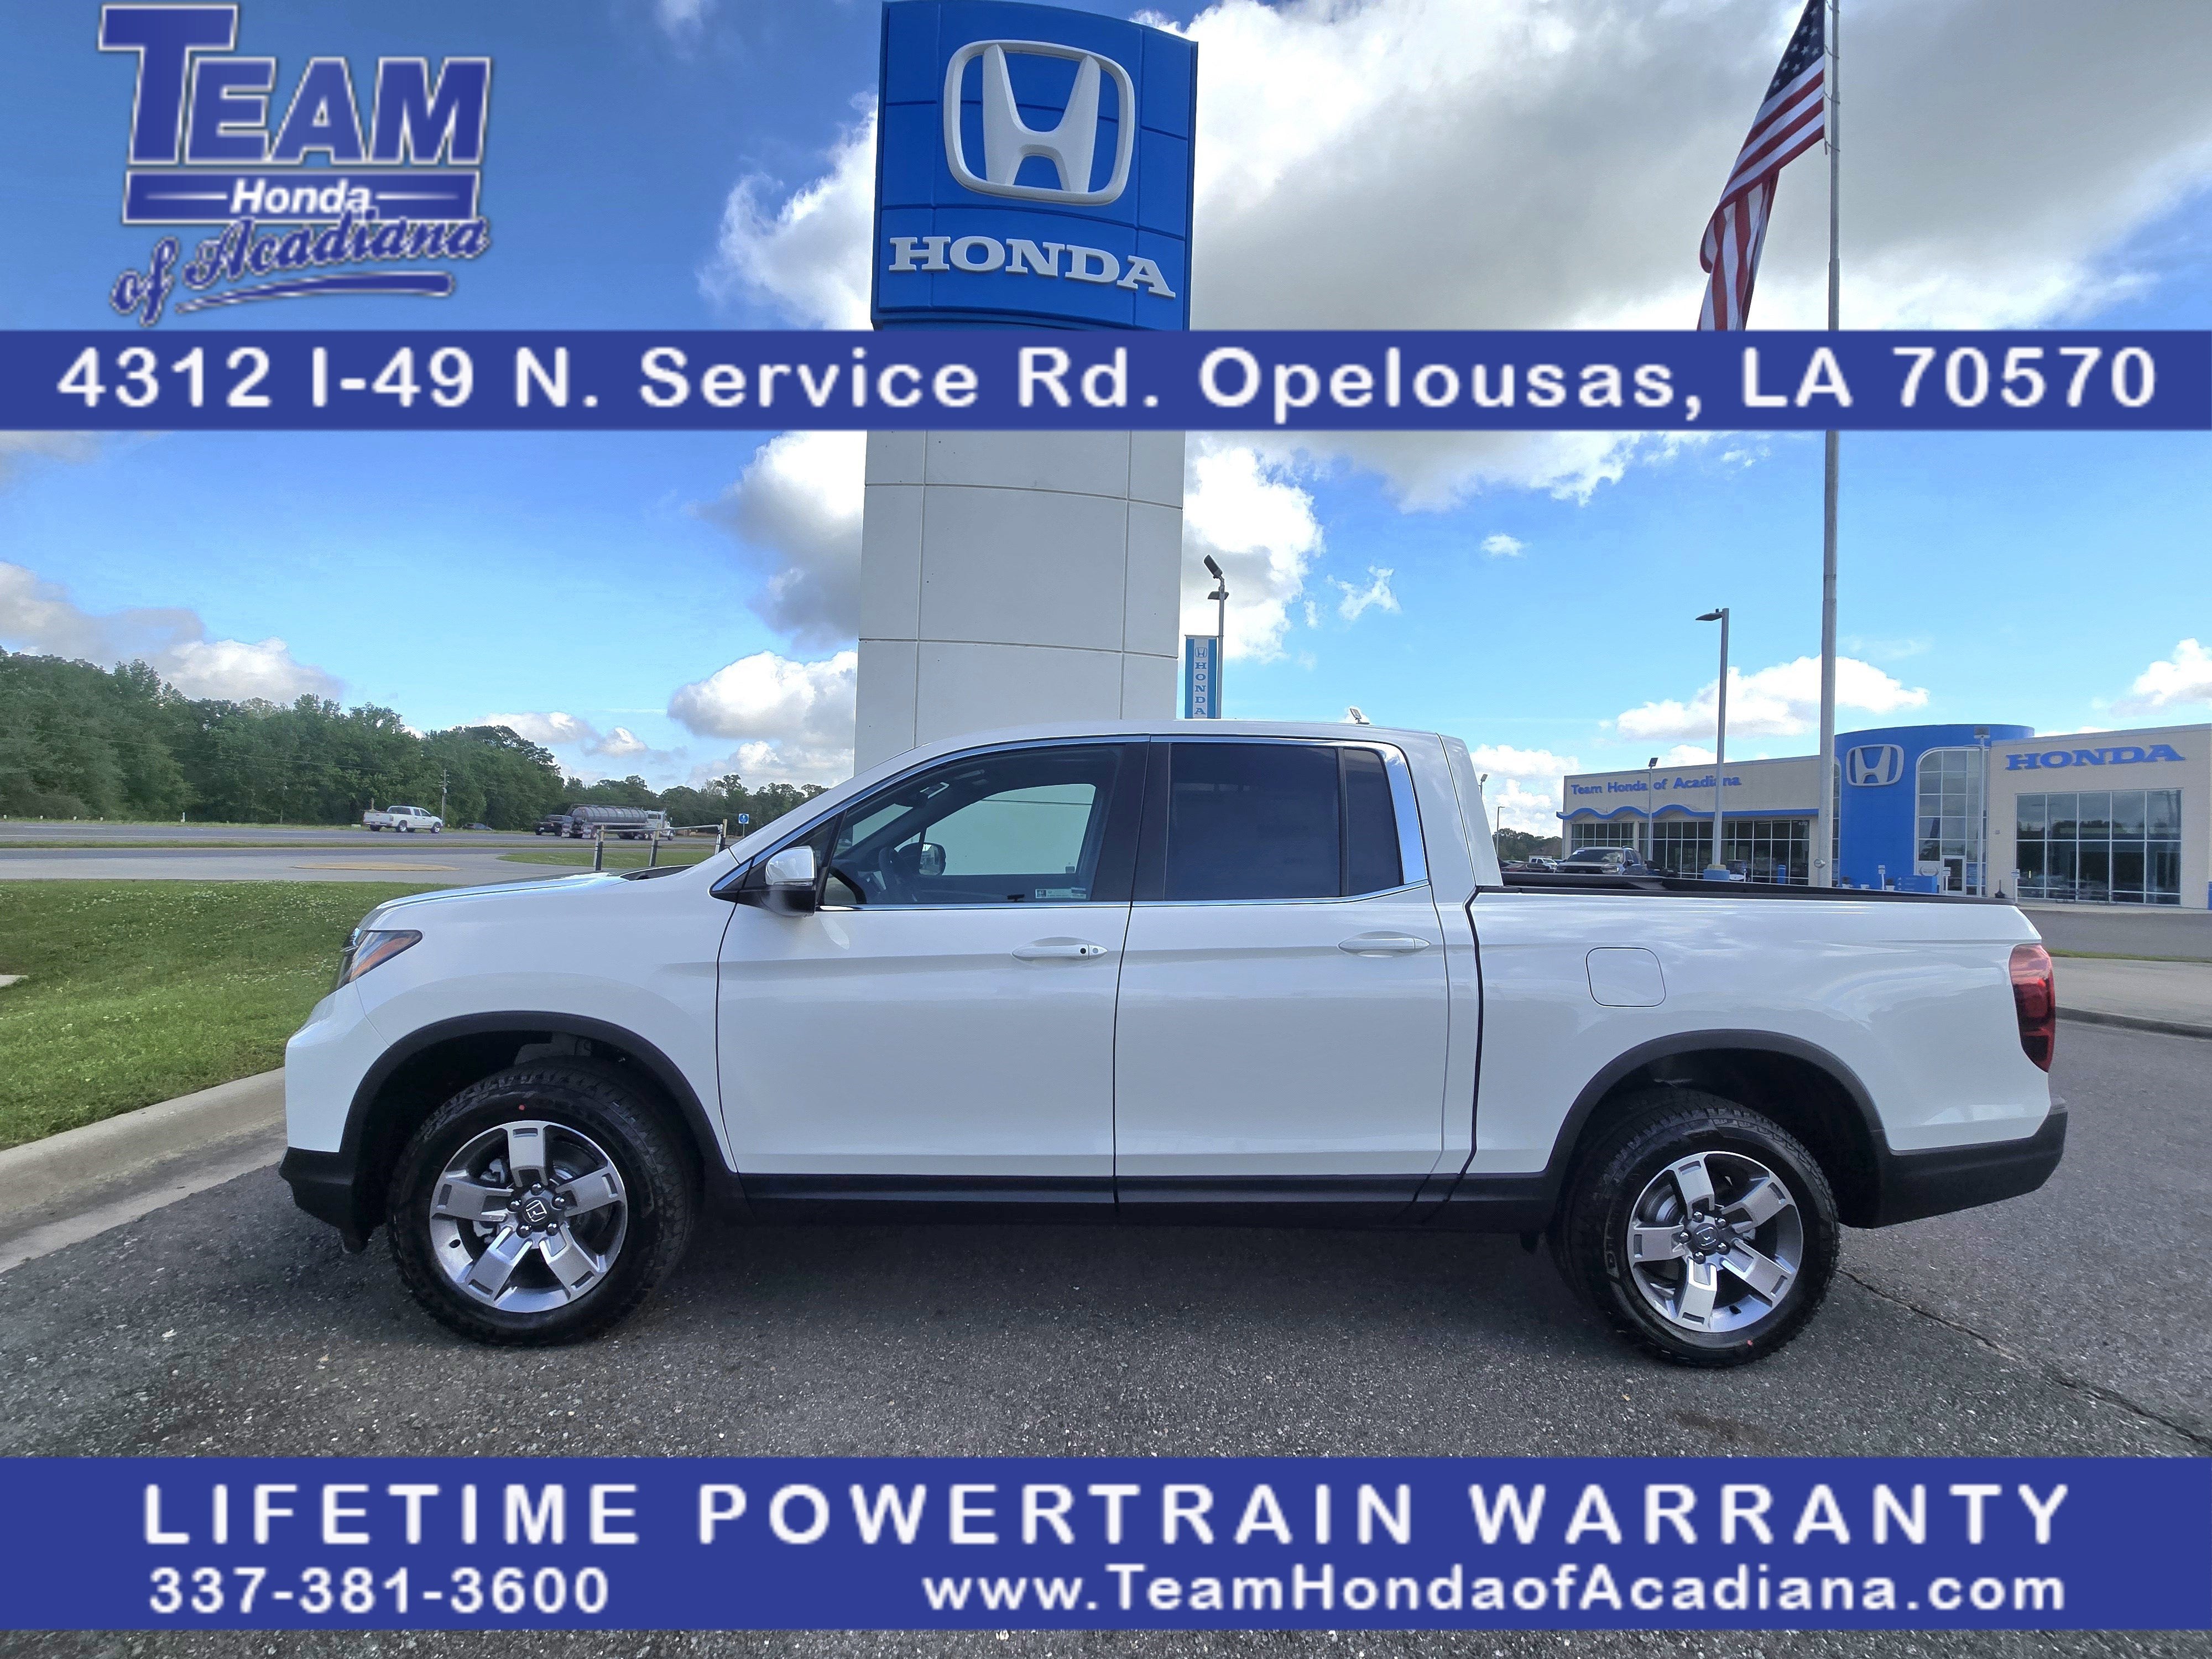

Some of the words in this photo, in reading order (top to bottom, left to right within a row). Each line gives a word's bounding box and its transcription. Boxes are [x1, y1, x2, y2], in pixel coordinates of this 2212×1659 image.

[888, 236, 1176, 299] HONDA
[1194, 662, 1207, 715] HONDA
[2005, 744, 2186, 770] HONDA
[1571, 784, 1603, 795] Team
[1607, 780, 1648, 793] Honda
[1653, 778, 1668, 790] of
